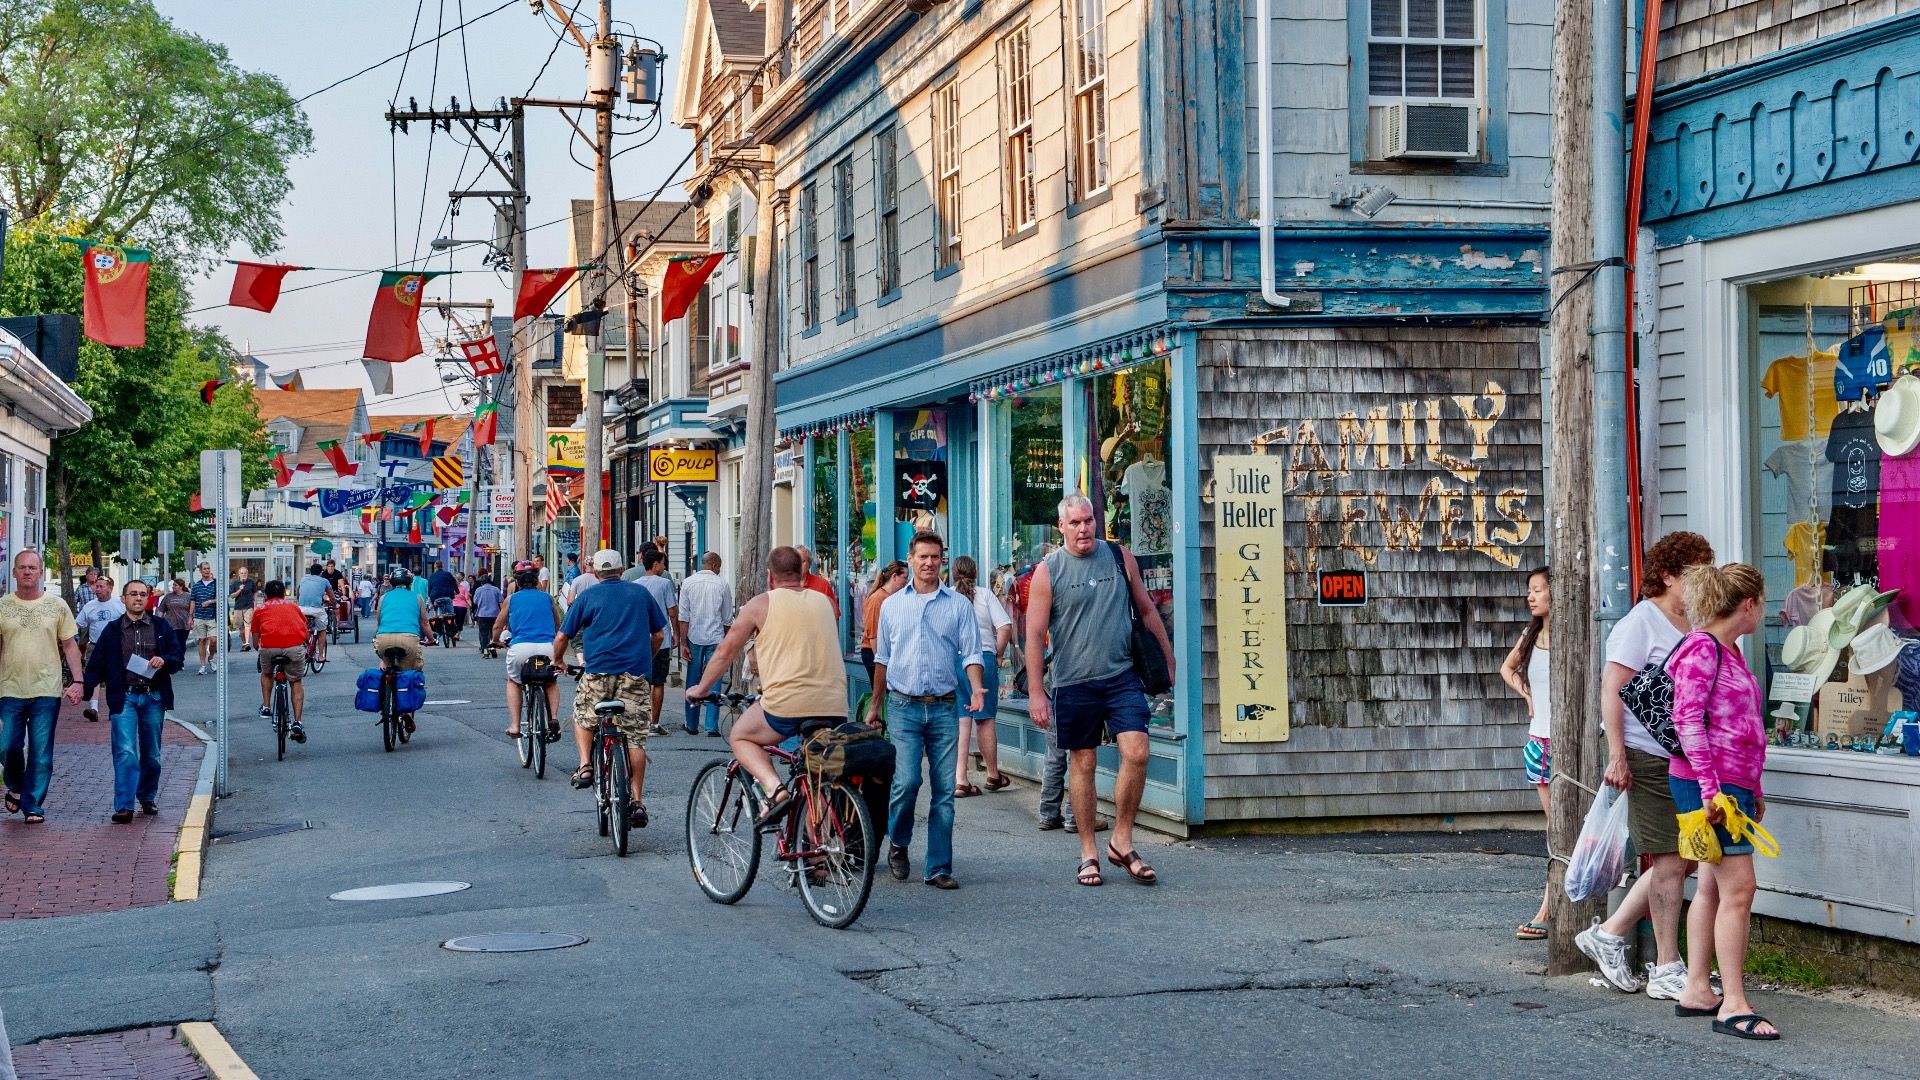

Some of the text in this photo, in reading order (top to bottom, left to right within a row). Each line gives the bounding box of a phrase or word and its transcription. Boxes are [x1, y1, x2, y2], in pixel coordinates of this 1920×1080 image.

[1870, 358, 1888, 377] 10
[910, 429, 926, 441] CAPE
[1249, 380, 1507, 493] AMILY
[676, 458, 714, 471] PULP
[1226, 468, 1271, 494] Julie
[1222, 501, 1278, 528] Heller
[1142, 567, 1172, 578] PEACE
[1143, 577, 1172, 592] LOVE
[1322, 575, 1364, 598] OPEN
[1238, 543, 1265, 690] GALLERY
[1837, 692, 1864, 706] Tilley
